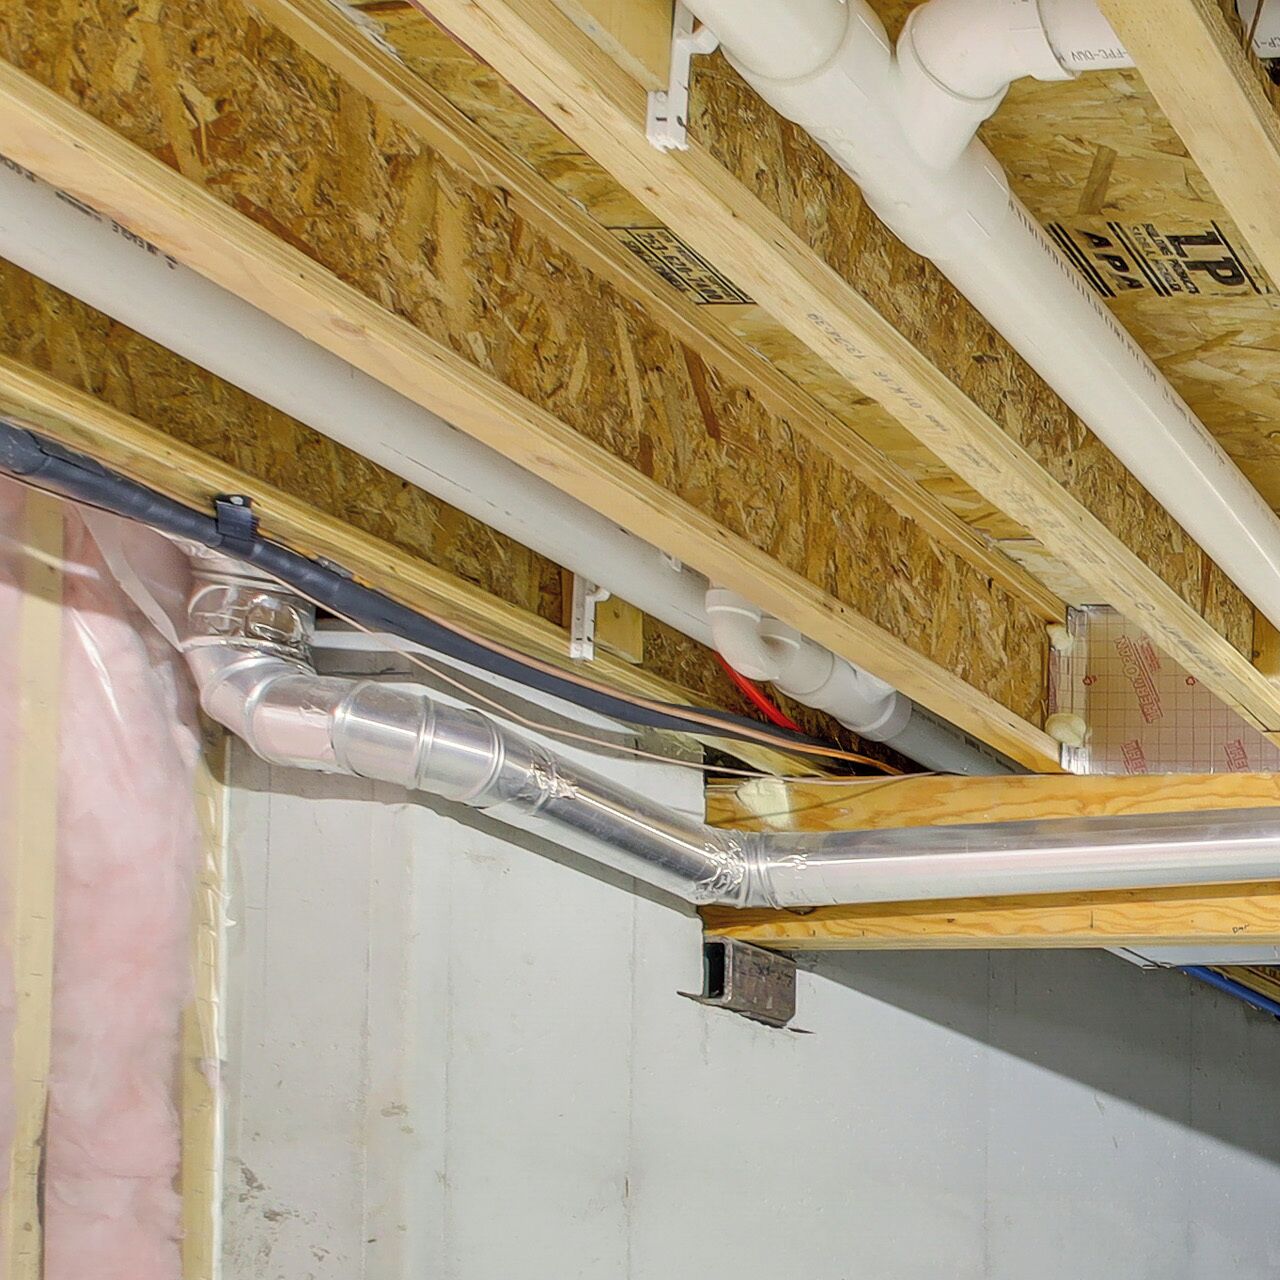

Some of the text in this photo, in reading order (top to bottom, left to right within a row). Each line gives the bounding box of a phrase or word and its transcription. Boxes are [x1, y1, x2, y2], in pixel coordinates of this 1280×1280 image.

[1076, 229, 1145, 291] APA
[1165, 230, 1246, 286] LP
[1115, 637, 1161, 724] THERMOPAN
